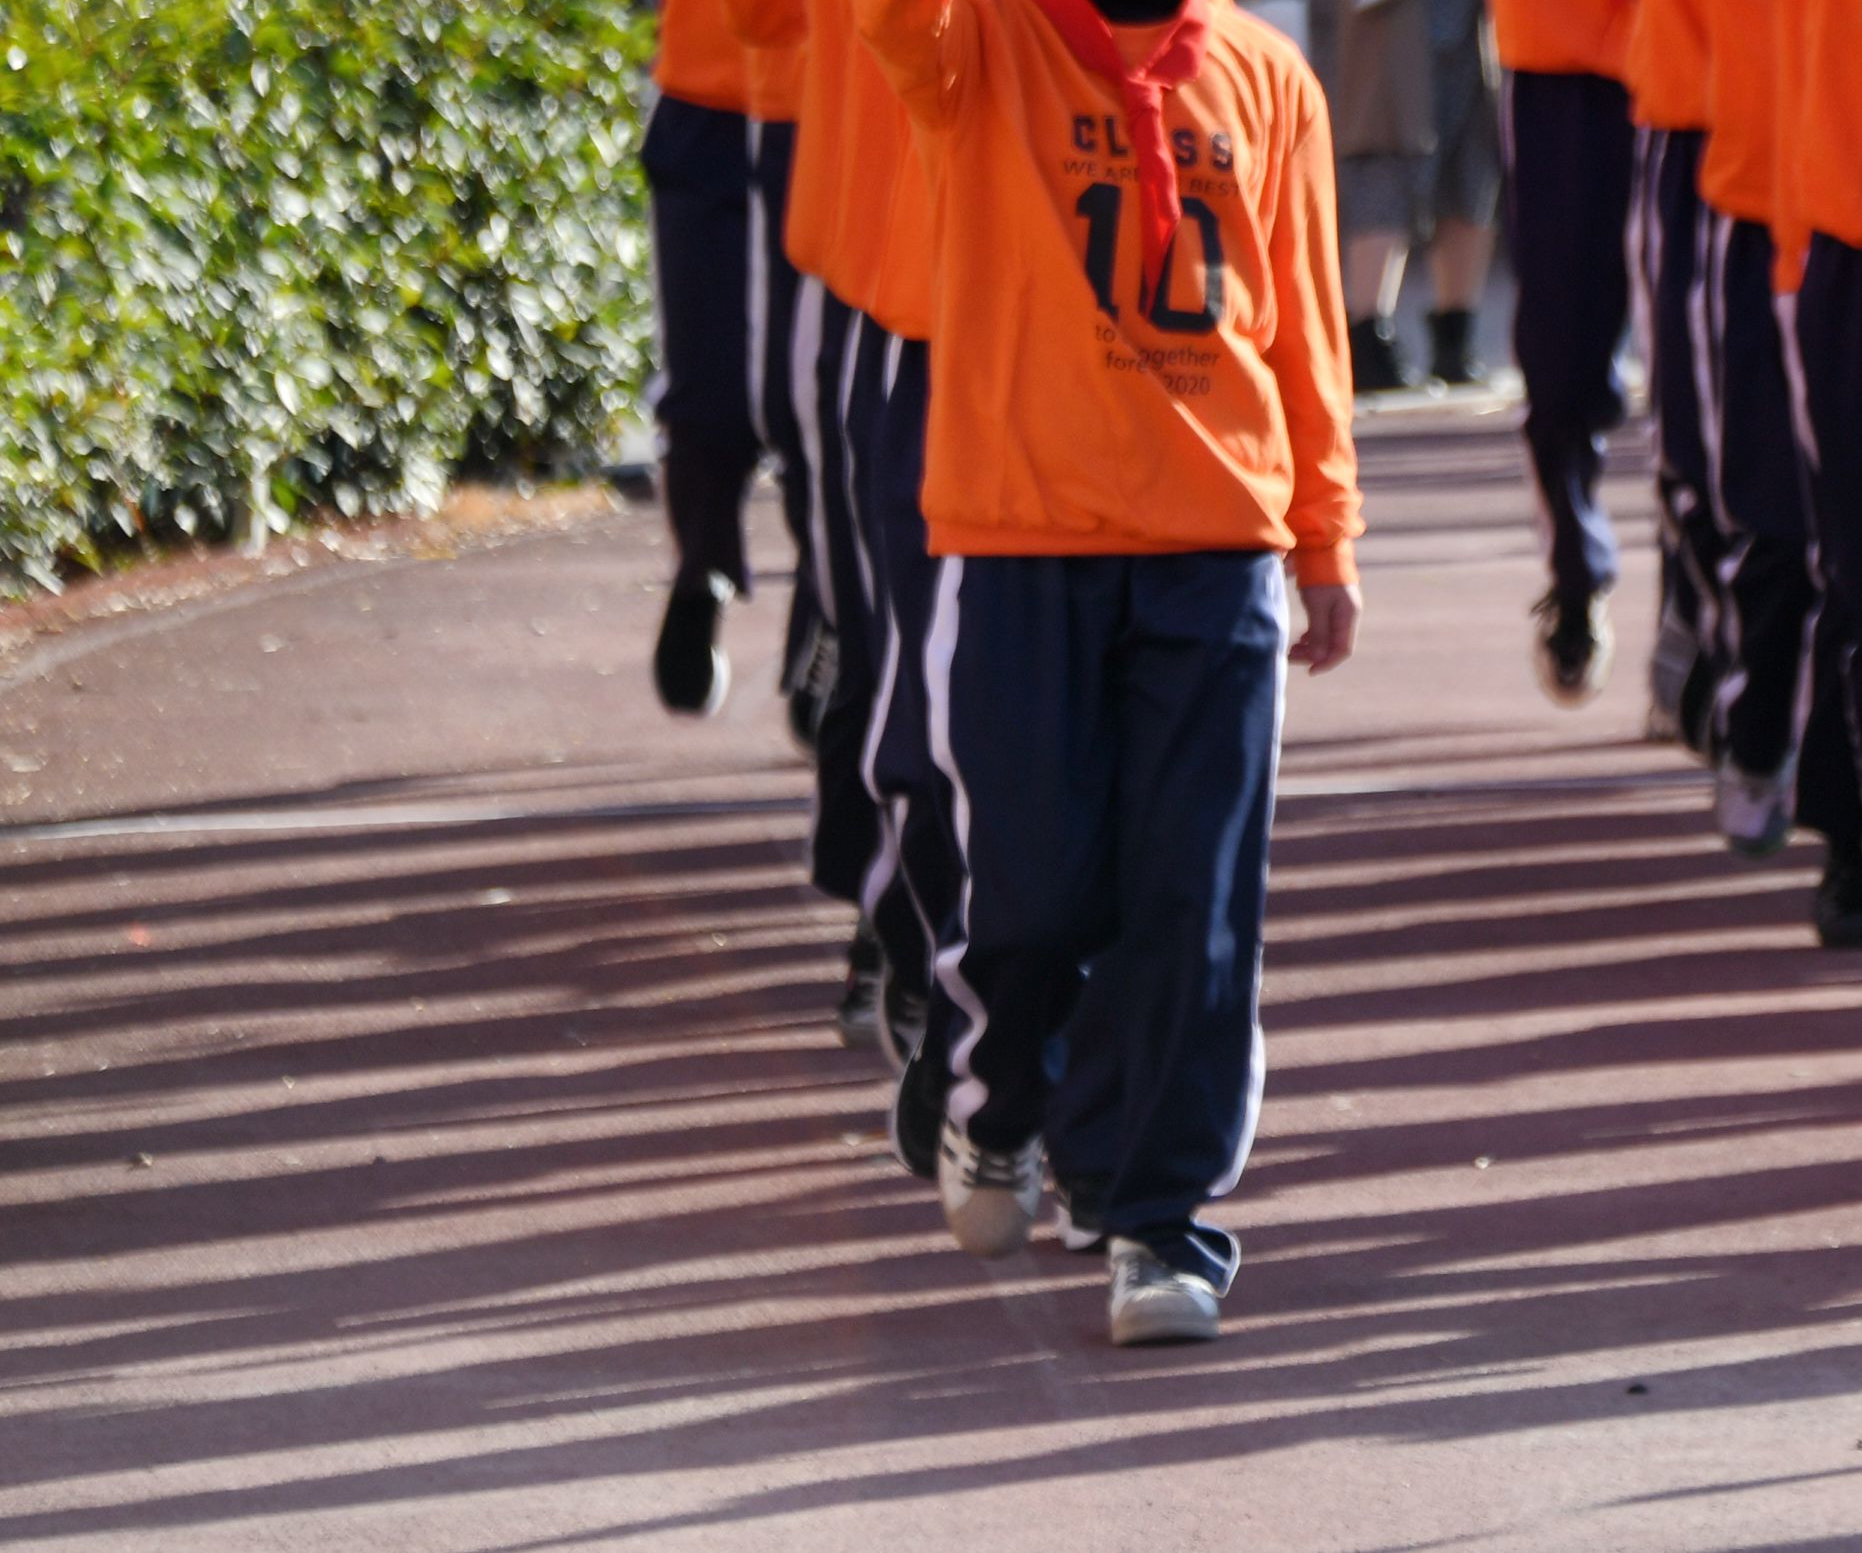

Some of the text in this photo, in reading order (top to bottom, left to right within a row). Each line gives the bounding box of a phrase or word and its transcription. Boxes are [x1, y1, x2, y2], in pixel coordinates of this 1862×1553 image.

[1063, 157, 1098, 175] WE
[1073, 114, 1234, 172] CLSS
[1075, 183, 1224, 335] 10
